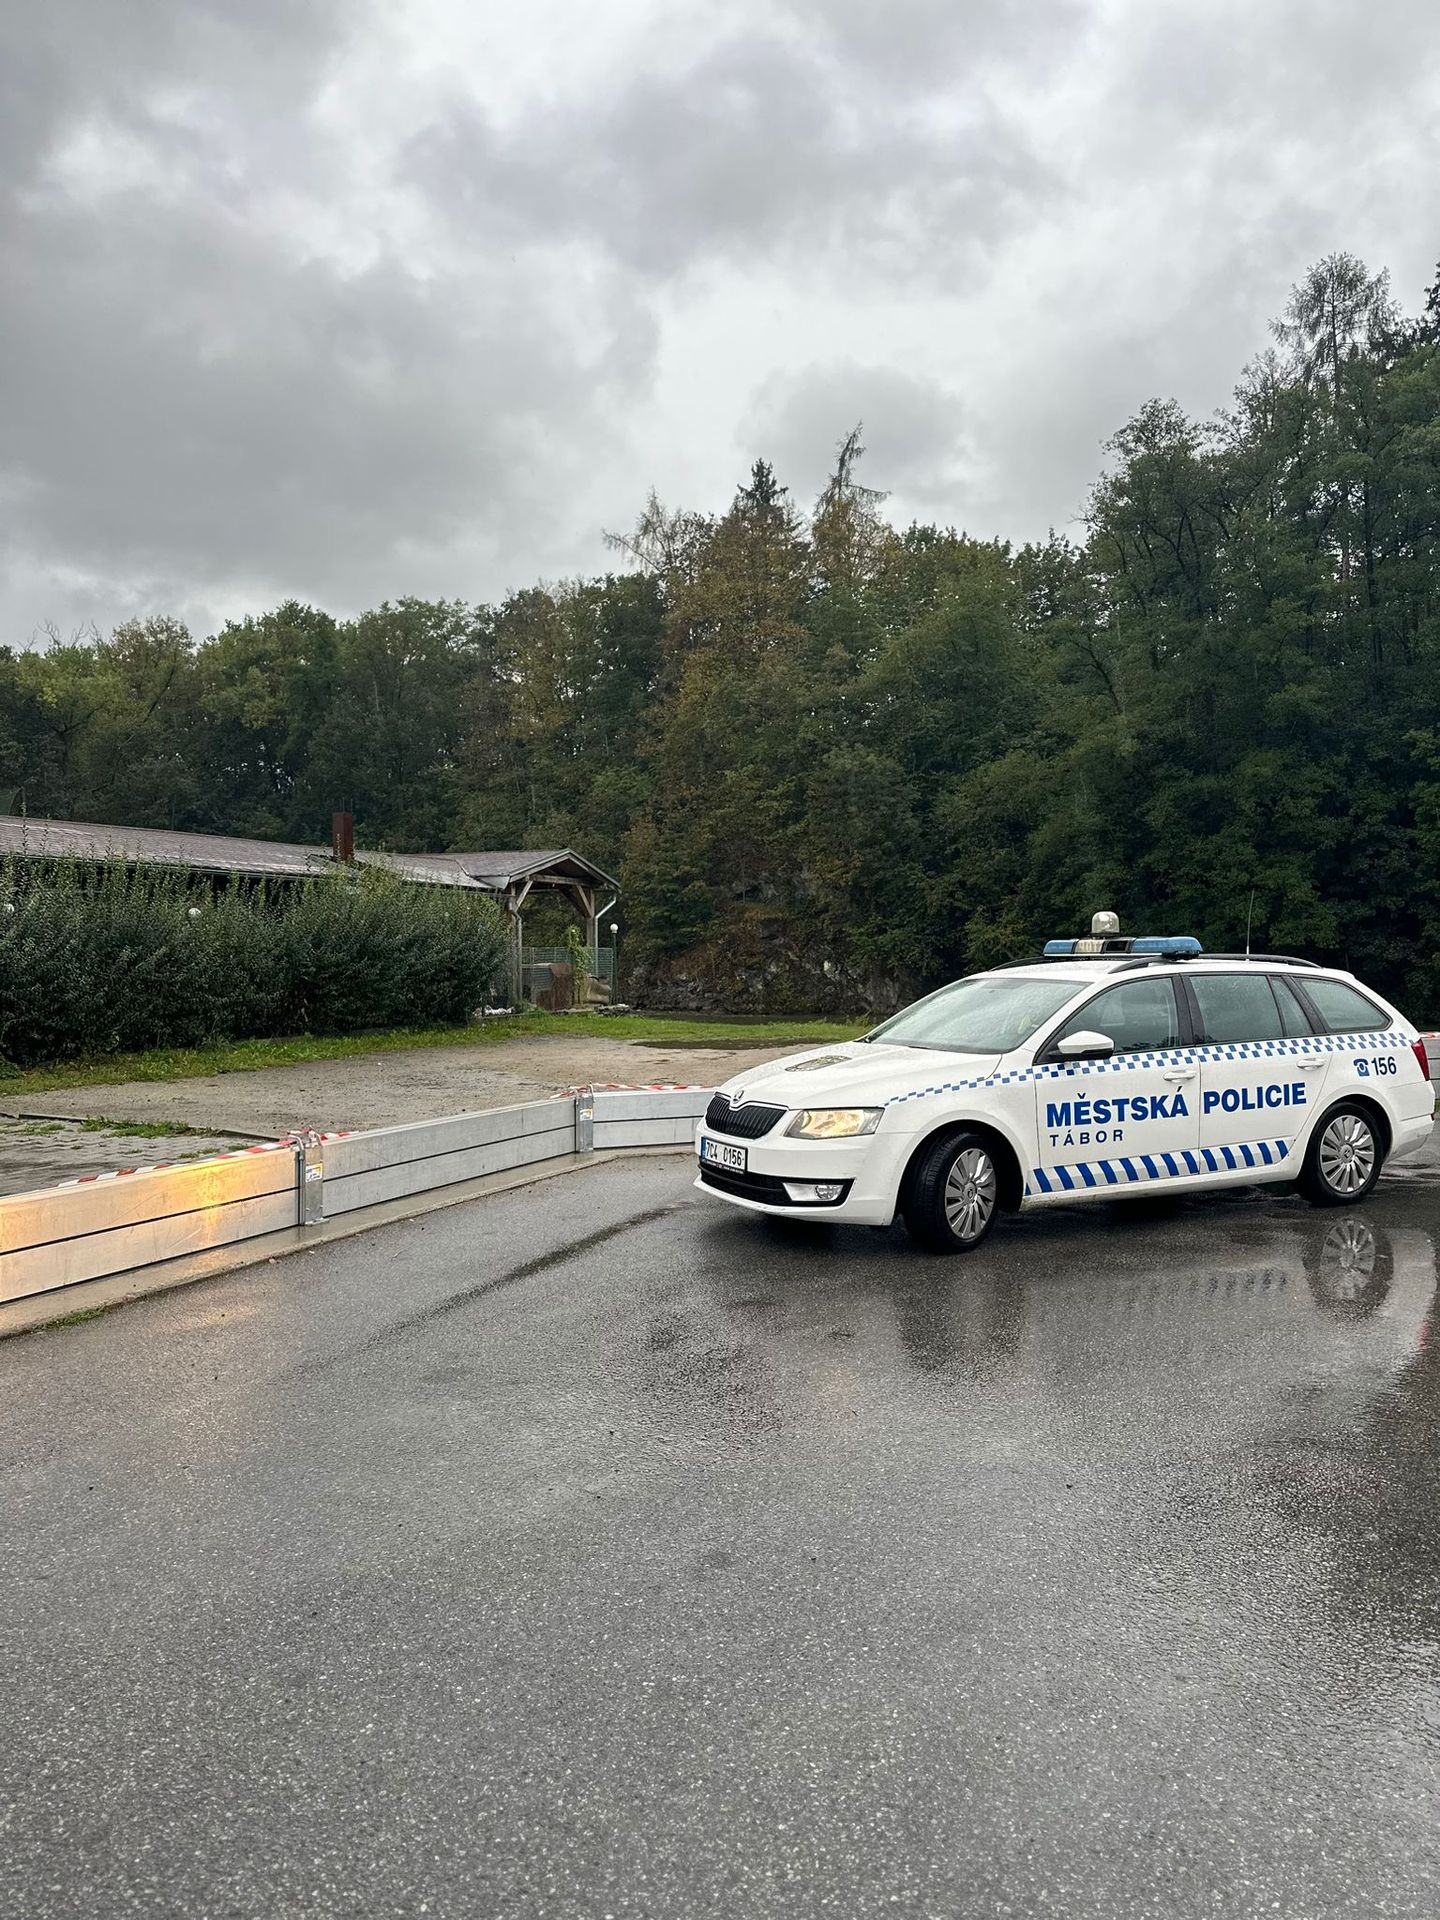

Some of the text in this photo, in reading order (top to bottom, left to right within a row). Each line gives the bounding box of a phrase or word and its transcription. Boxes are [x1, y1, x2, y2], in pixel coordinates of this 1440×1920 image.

[1371, 1056, 1397, 1076] 156
[1046, 1082, 1307, 1127] MĚSTSKÁ POLICIE
[1050, 1129, 1123, 1147] TÁBOR
[706, 1142, 718, 1160] 7C4
[723, 1147, 742, 1167] 0156
